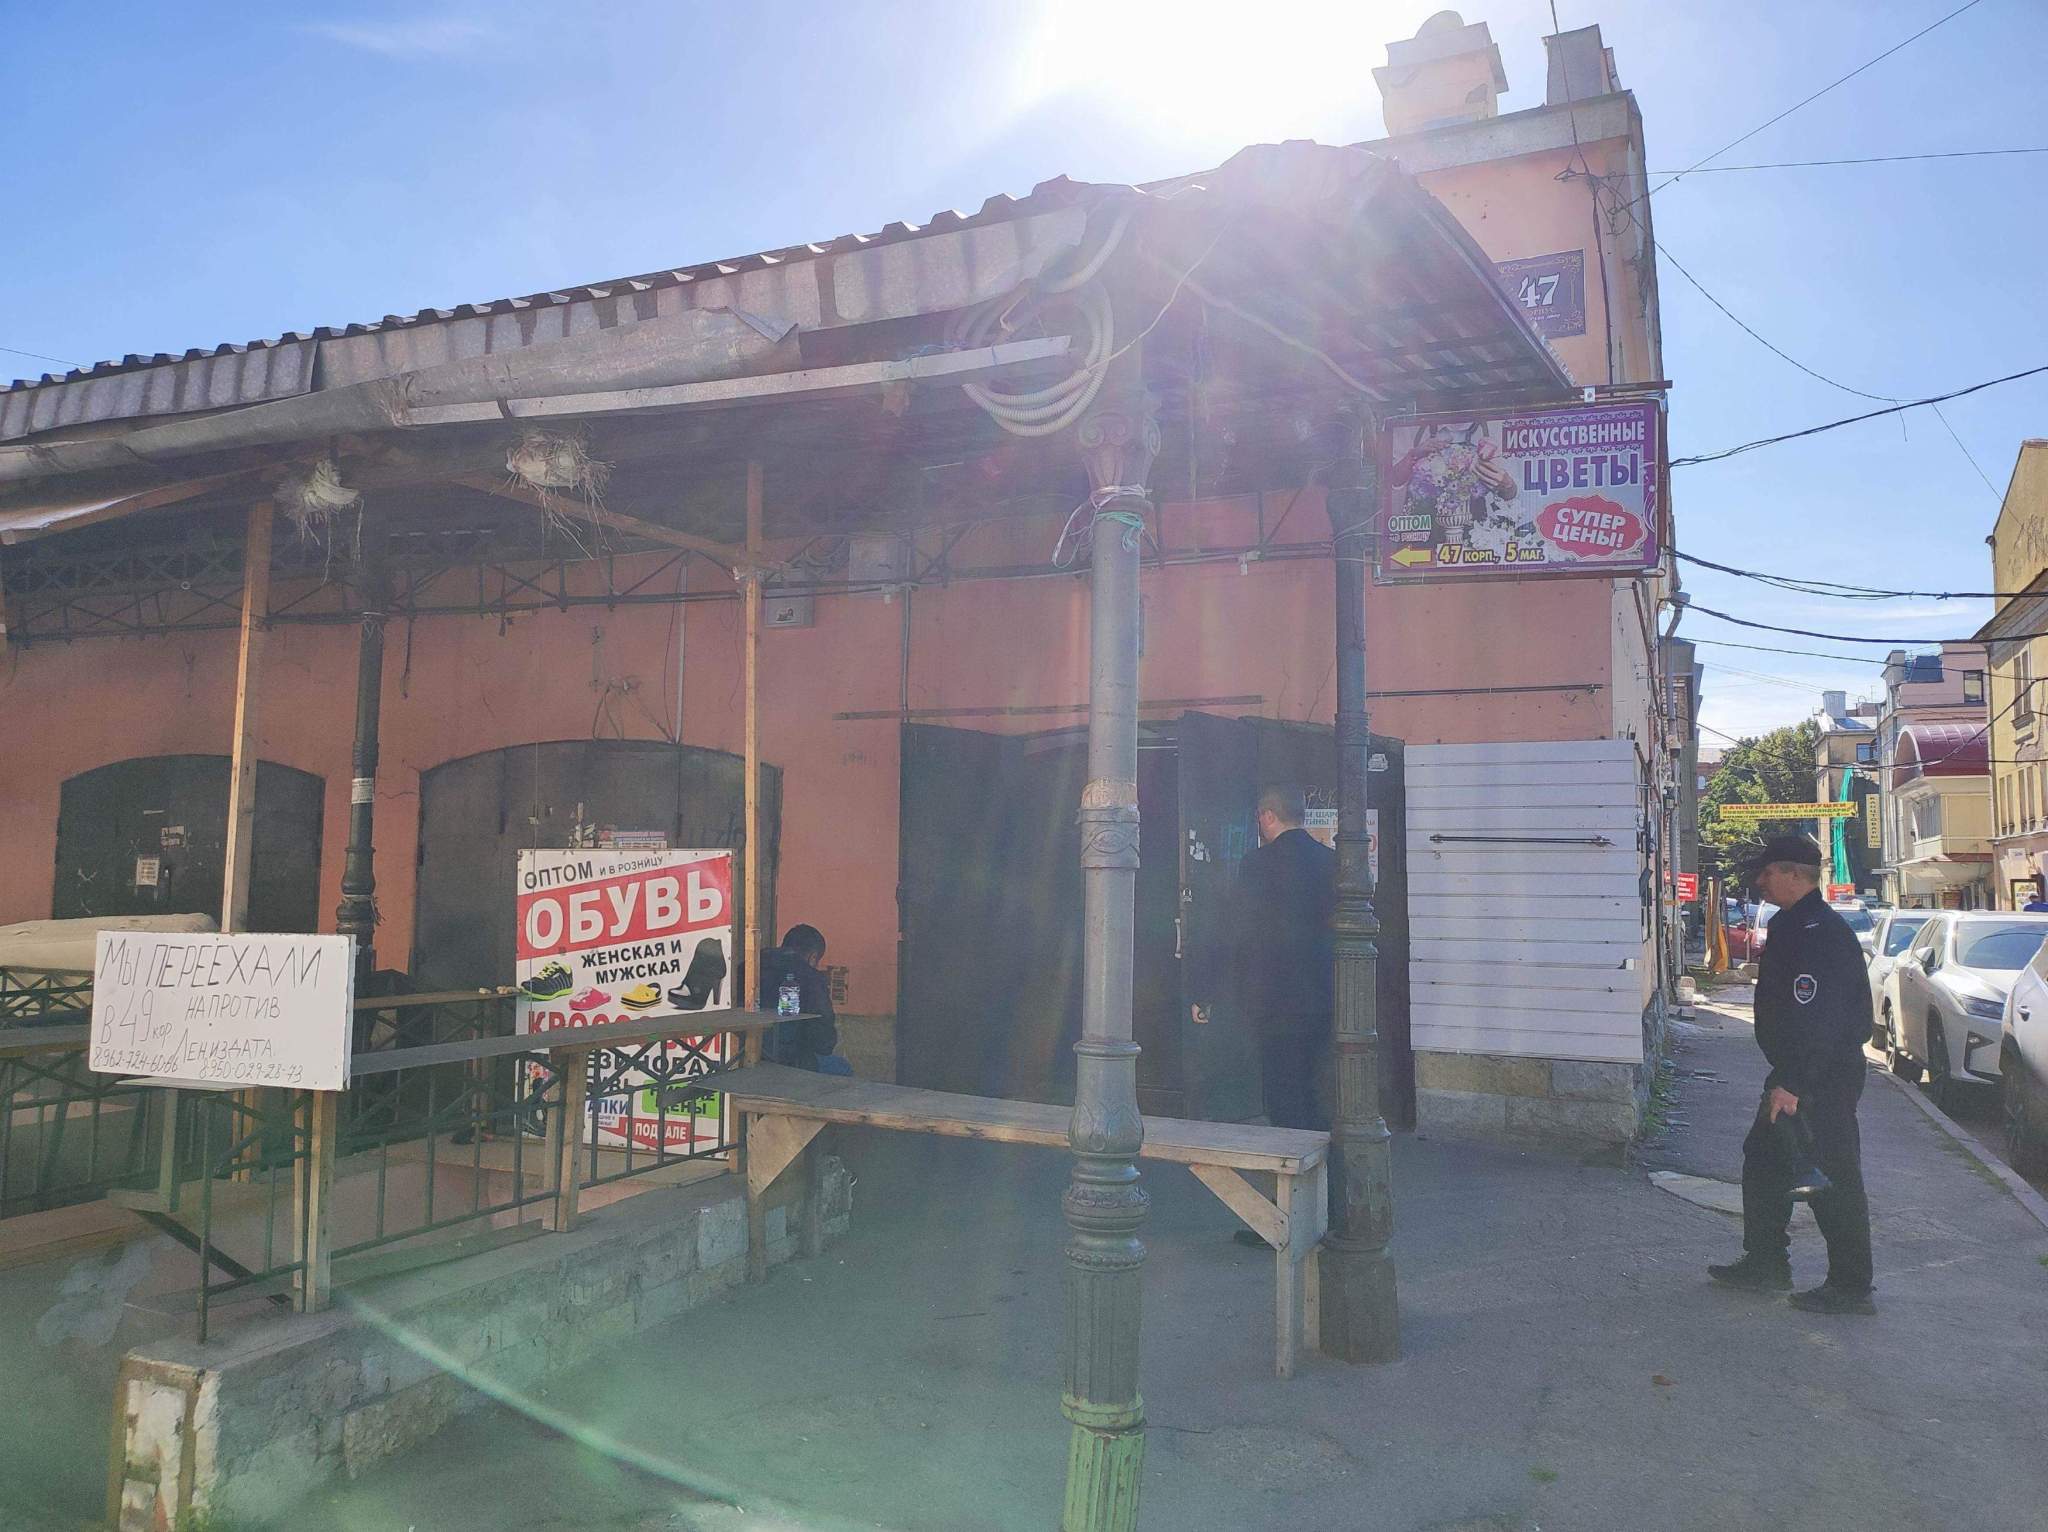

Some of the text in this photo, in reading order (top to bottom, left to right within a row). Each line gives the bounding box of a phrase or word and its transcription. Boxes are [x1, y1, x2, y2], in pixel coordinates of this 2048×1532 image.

[1519, 274, 1560, 308] 47
[1506, 421, 1645, 450] ИСКУССТВЕННЫЕ
[1523, 453, 1640, 494] ЦВЕТЫ
[1388, 515, 1431, 531] ОПТОМ
[1556, 507, 1627, 531] СУПЕР
[1552, 523, 1625, 548] ЦЕНЫ!
[1438, 544, 1463, 564] 47
[1504, 542, 1517, 562] 5
[1519, 549, 1545, 562] МАГ.
[524, 861, 593, 890] ОПТОМ
[618, 856, 663, 873] РОЗНИЦУ
[525, 870, 724, 950] ОБУВЬ
[146, 943, 322, 988] ПЕРЕЕХАЛИ
[581, 940, 682, 969] ЖЕНСКАЯ И
[595, 958, 681, 985] МУЖСКАЯ
[119, 989, 154, 1046] 49
[184, 994, 281, 1022] НАПРОТИВ
[635, 1122, 687, 1141] ПОДАЛЕ
